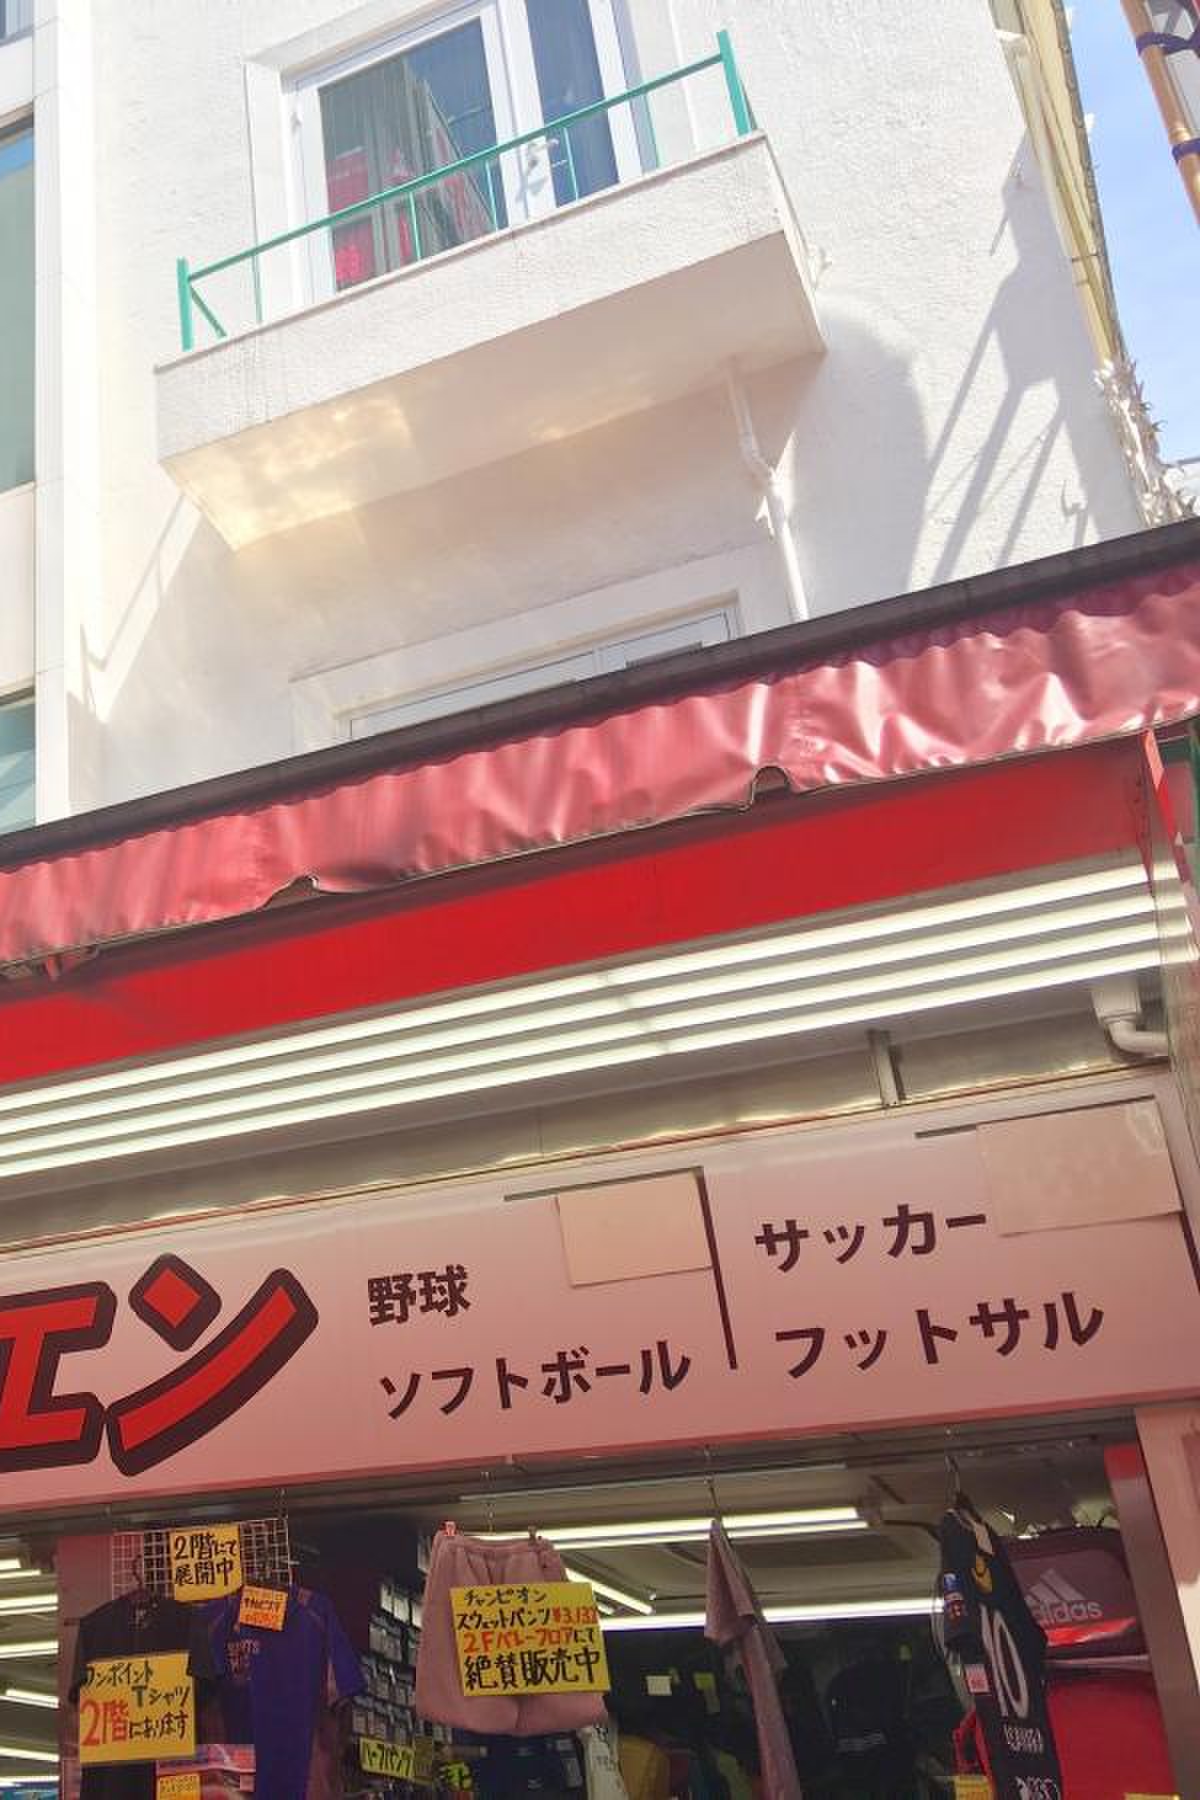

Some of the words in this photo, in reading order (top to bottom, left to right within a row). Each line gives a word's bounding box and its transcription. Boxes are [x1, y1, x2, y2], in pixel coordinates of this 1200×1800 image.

[755, 1203, 987, 1274] サッカー
[367, 1264, 471, 1326] 野球
[775, 1291, 1104, 1379] フットサル
[380, 1339, 692, 1420] ソフトボール
[173, 1533, 238, 1561] 2階にて
[174, 1557, 234, 1587] 展開中
[463, 1646, 601, 1690] 絶賛販売中
[131, 1685, 191, 1709] Tシャツ
